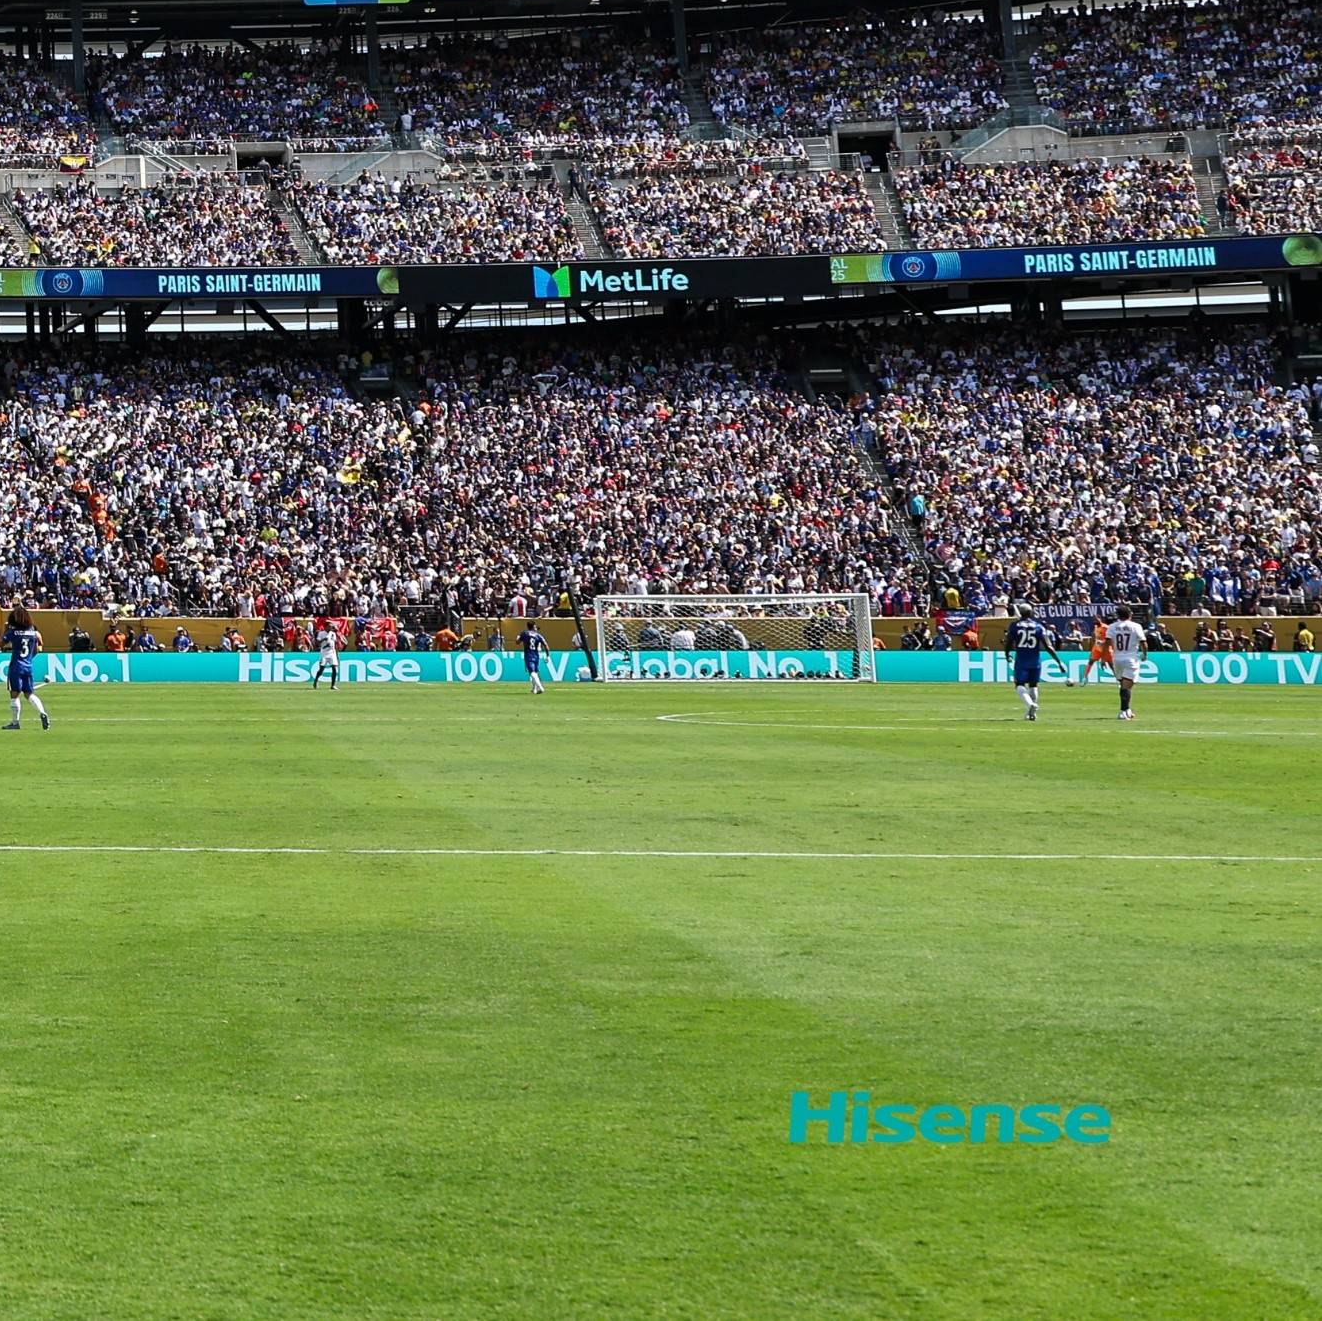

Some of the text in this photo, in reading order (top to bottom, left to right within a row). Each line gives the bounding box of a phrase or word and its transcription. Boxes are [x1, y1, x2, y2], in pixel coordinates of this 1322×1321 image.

[1024, 246, 1216, 273] PARIS SAINT-GERMAIN
[158, 273, 321, 294] PARIS SAINT-GERMAIN
[580, 268, 688, 293] MetLife
[831, 270, 845, 282] 25
[1034, 605, 1046, 617] SG
[1050, 605, 1073, 617] CLUB
[1076, 605, 1098, 617] NEW
[19, 637, 29, 658] 3
[1017, 629, 1037, 649] 25
[1116, 633, 1130, 651] 87
[606, 650, 727, 678] Global
